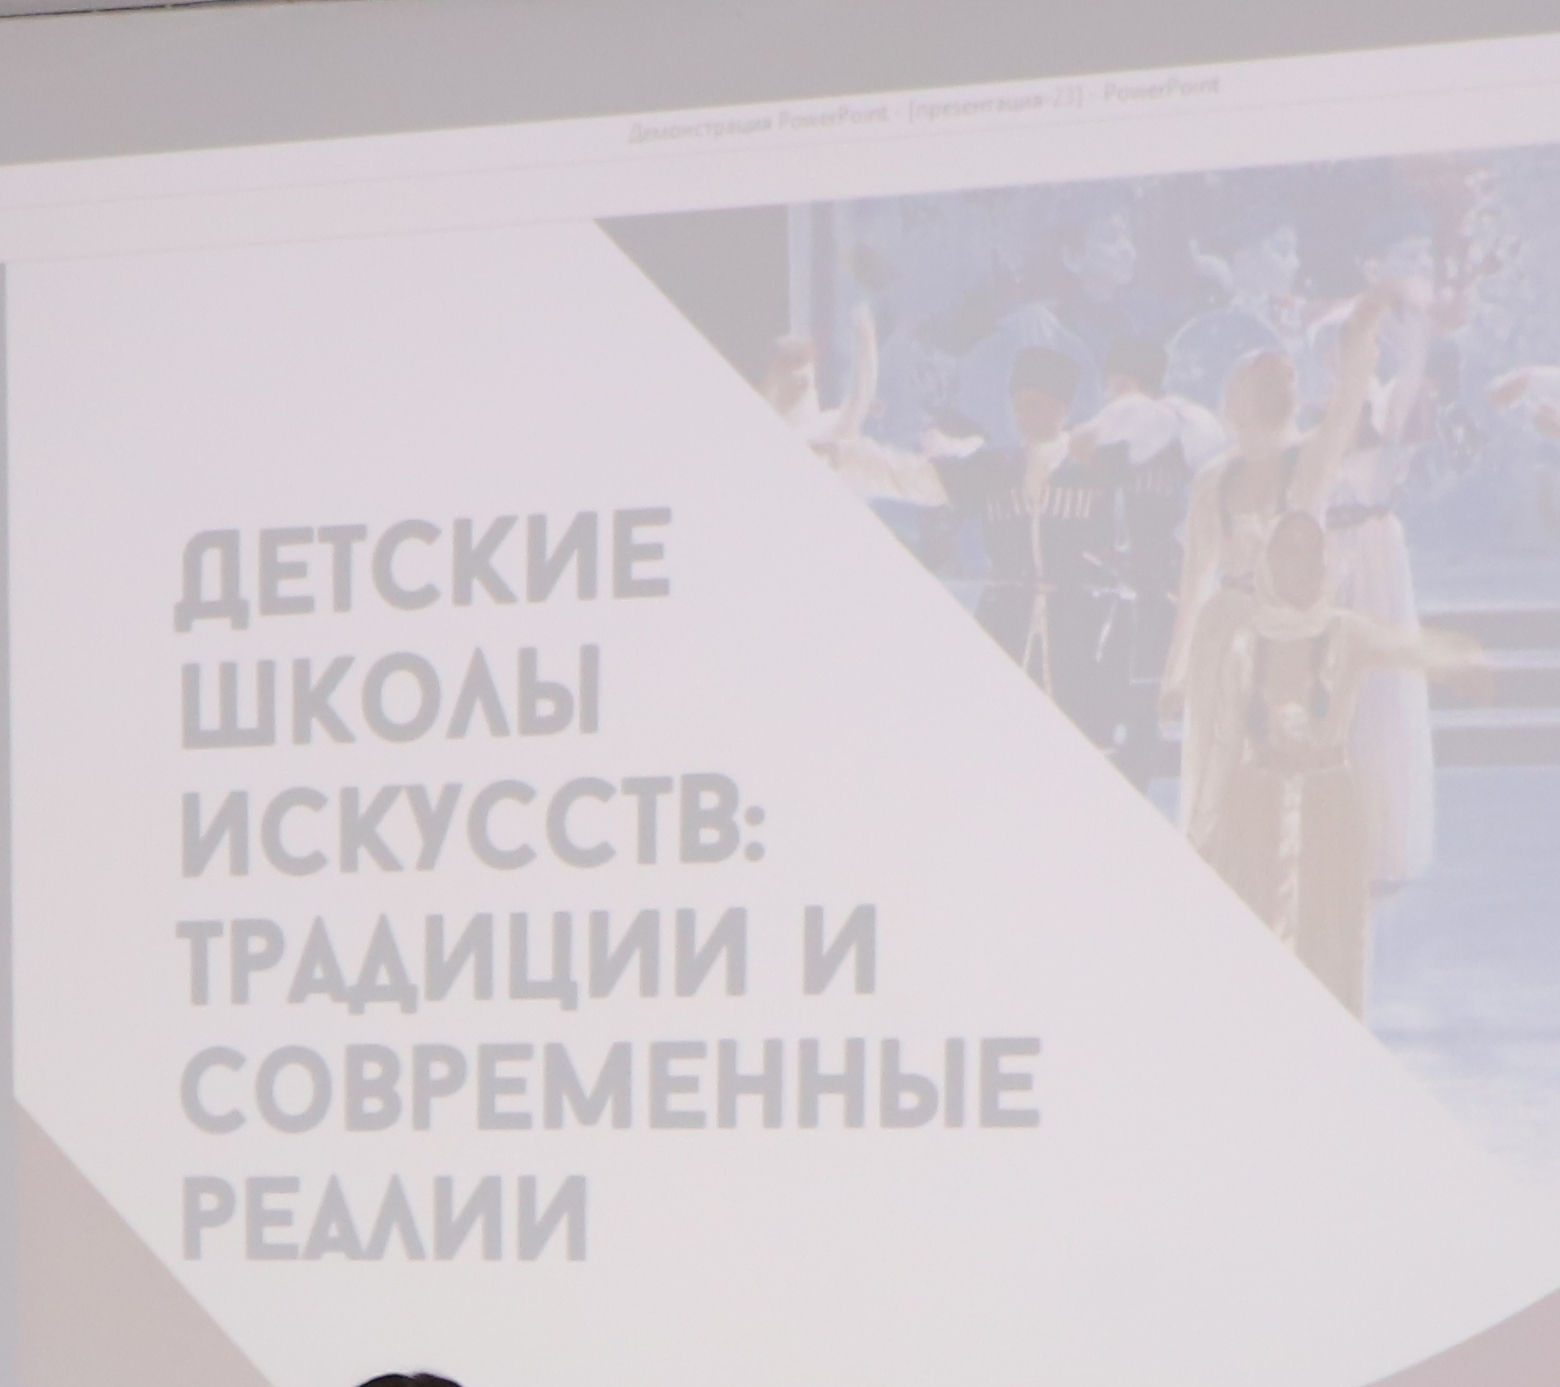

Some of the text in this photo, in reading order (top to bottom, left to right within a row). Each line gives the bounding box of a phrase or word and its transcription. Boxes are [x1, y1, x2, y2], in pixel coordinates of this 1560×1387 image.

[778, 105, 888, 130] PowerPoint
[1103, 76, 1221, 103] PowerPoint
[173, 507, 672, 632] ДЕТСКИЕ
[180, 644, 599, 750] ШКОЛЫ
[180, 772, 766, 878] ИСКУССТВ:
[174, 903, 877, 1014] ТРАДИЦИИ И
[179, 1036, 1042, 1135] СОВРЕМЕННЫЕ
[181, 1173, 588, 1262] РЕАЛИИ
